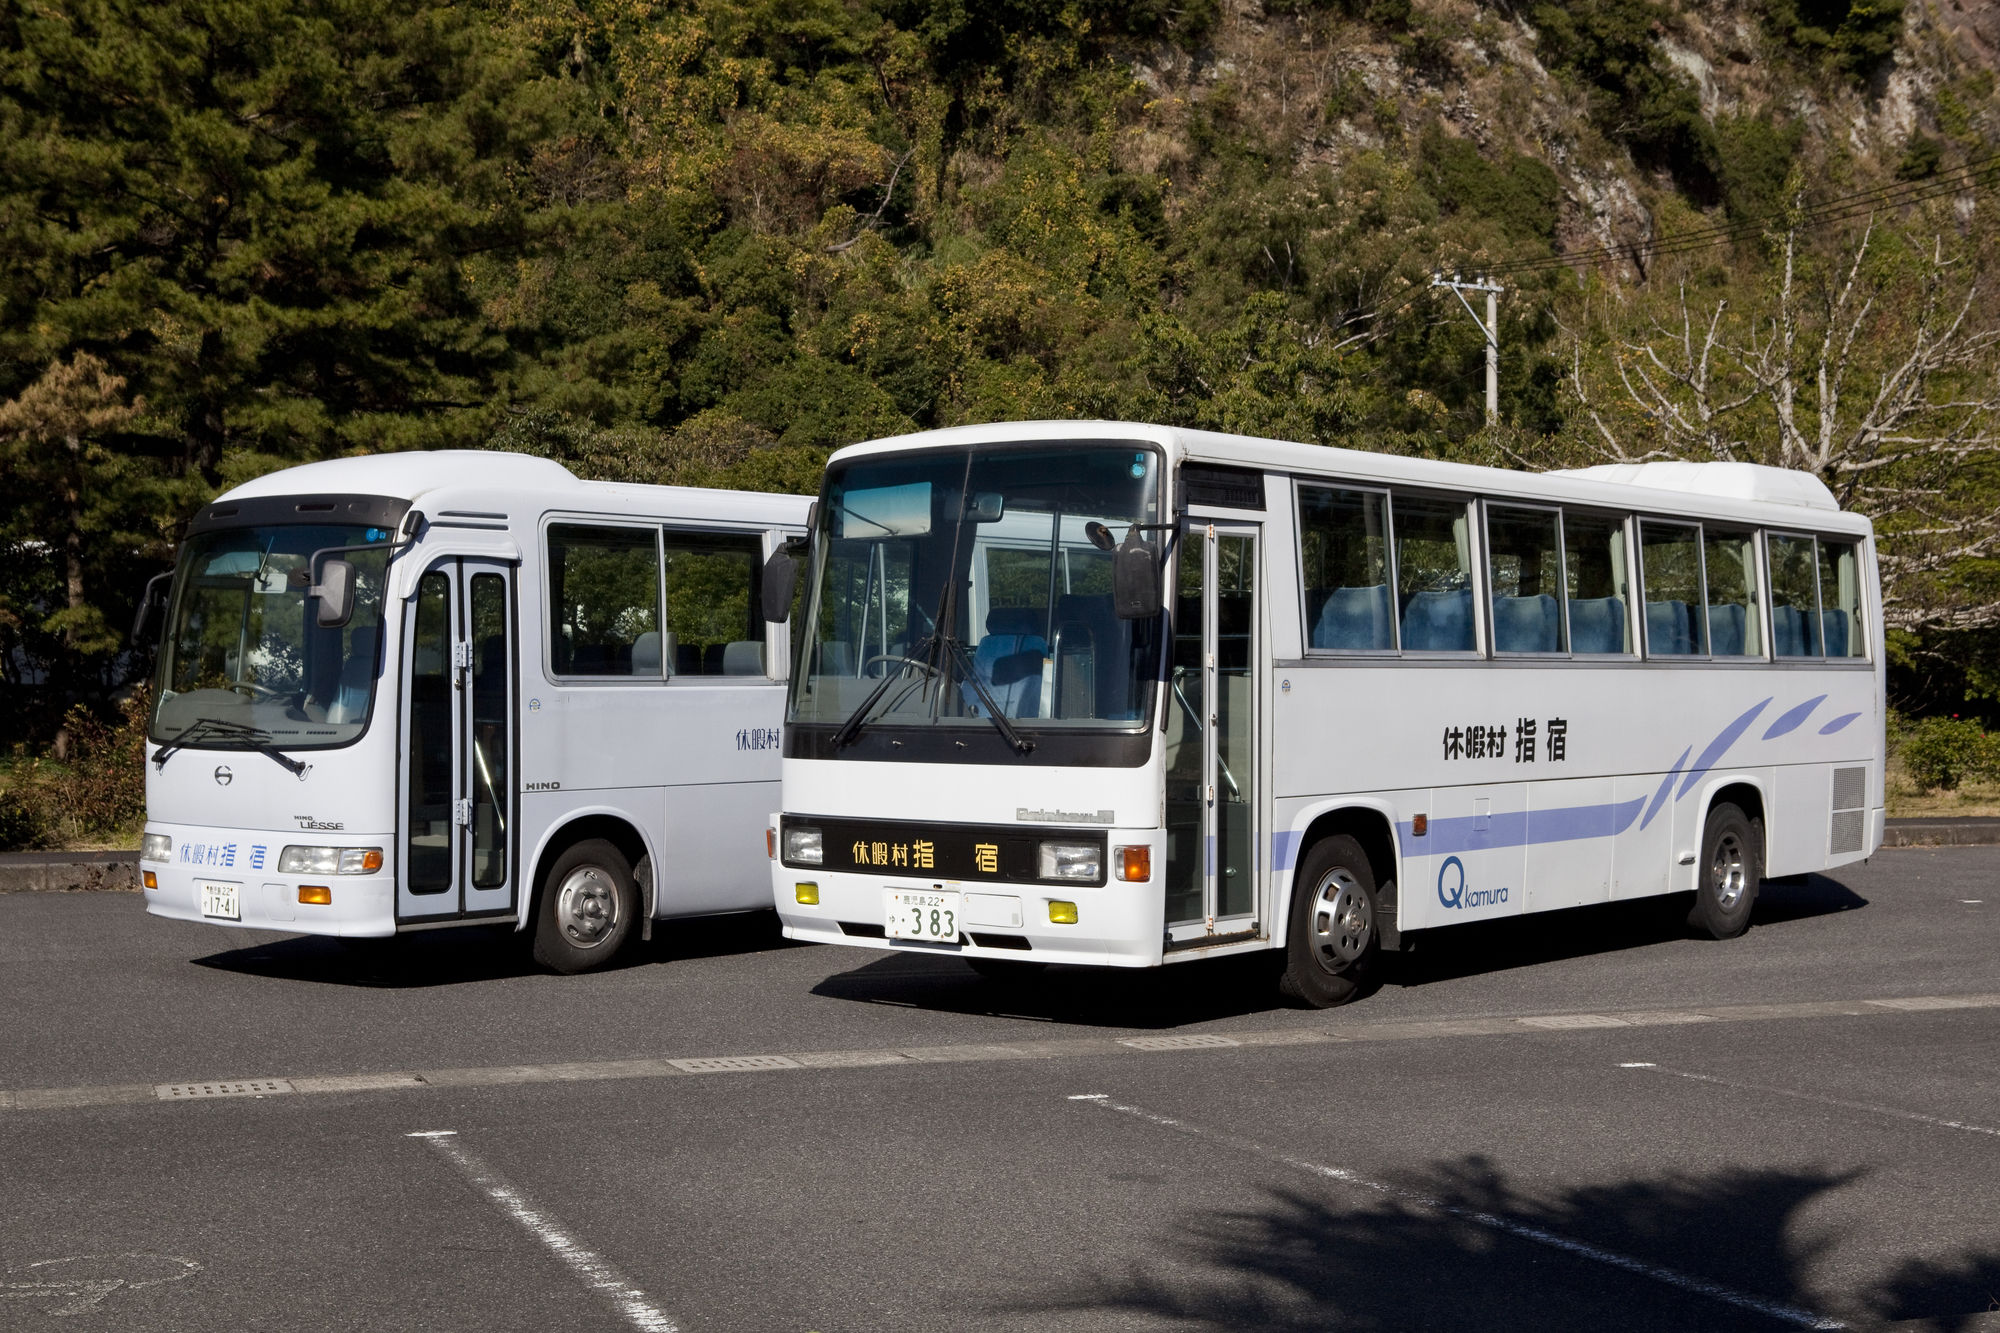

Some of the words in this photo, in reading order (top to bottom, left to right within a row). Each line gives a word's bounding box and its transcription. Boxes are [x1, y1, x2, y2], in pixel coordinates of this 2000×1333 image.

[736, 728, 780, 751] 休暇村
[526, 781, 561, 790] HINO
[928, 896, 940, 907] 22
